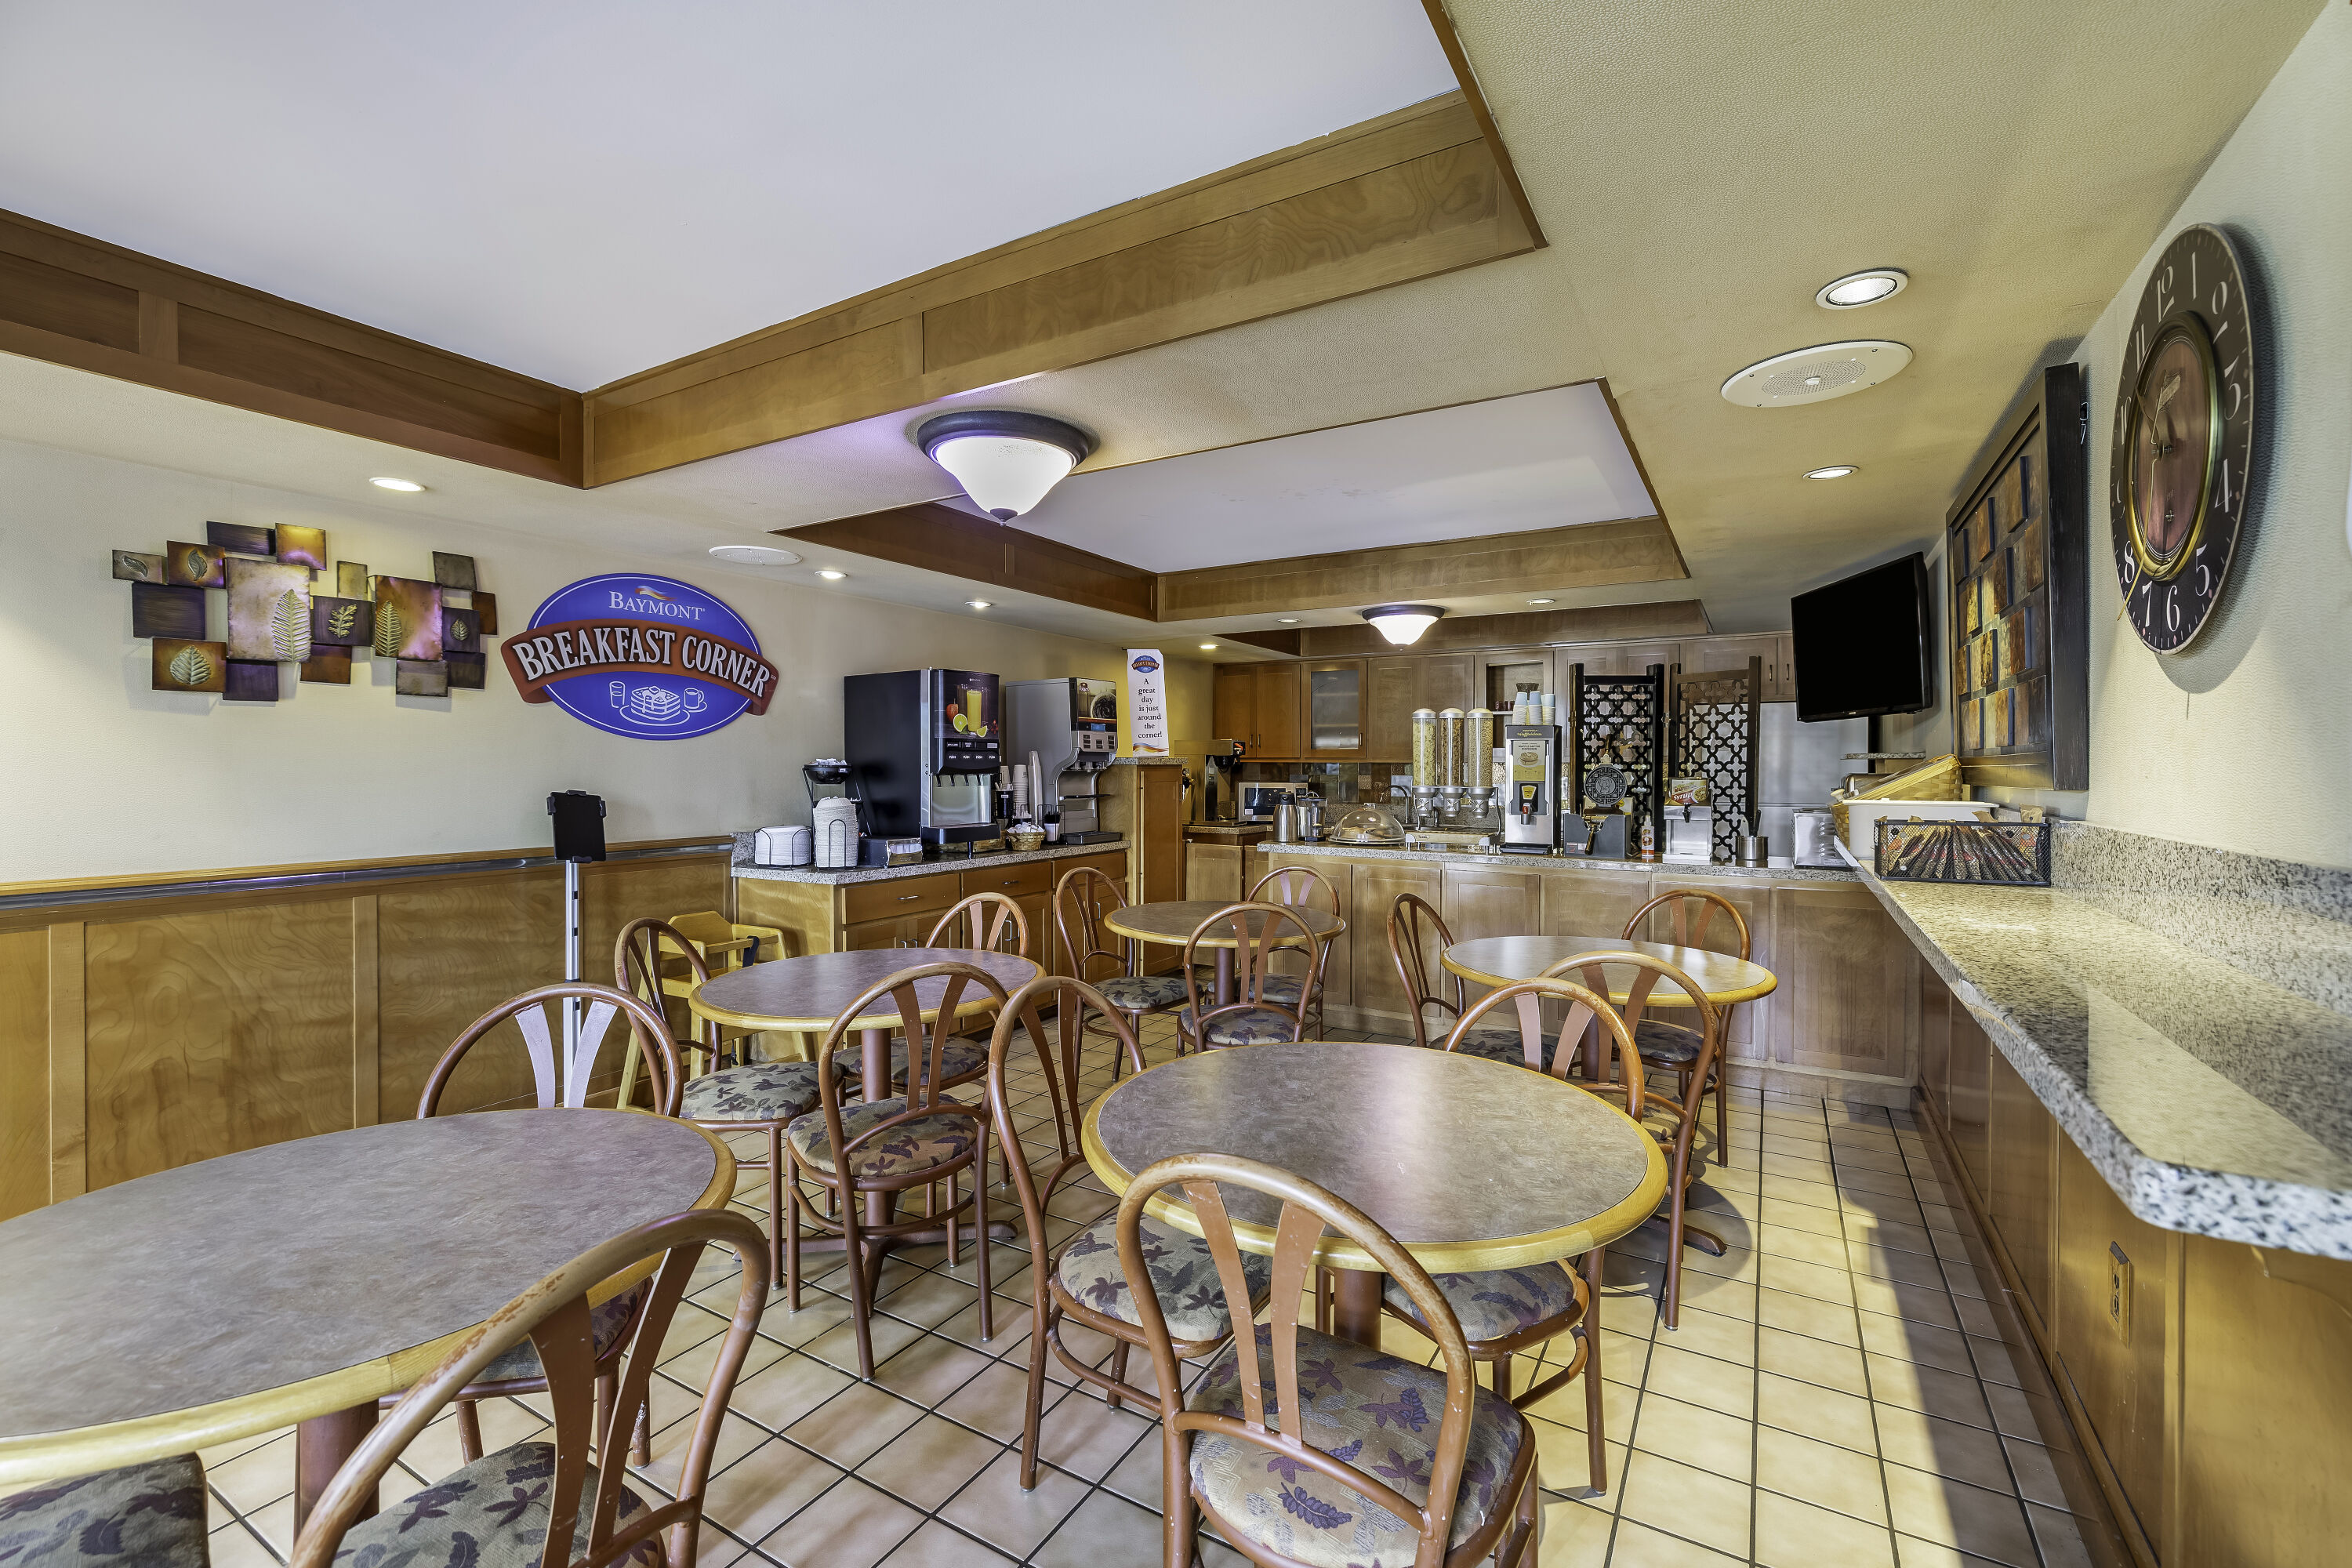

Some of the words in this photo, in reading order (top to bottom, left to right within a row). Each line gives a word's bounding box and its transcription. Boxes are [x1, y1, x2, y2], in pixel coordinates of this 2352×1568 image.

[2157, 265, 2175, 323] 12
[2191, 251, 2198, 301] 1
[2212, 281, 2228, 343] 2
[2224, 355, 2241, 420] 3
[2214, 458, 2233, 514] 4
[2124, 540, 2136, 583] 8
[2195, 543, 2210, 597] 5
[608, 590, 704, 620] BAYMONT
[2142, 580, 2153, 627] 7
[2166, 585, 2180, 632] 6
[513, 627, 677, 681] BREAKFAST
[681, 636, 771, 698] CORNER
[1138, 688, 1156, 696] great
[1141, 695, 1153, 705] day
[1146, 705, 1159, 713] just
